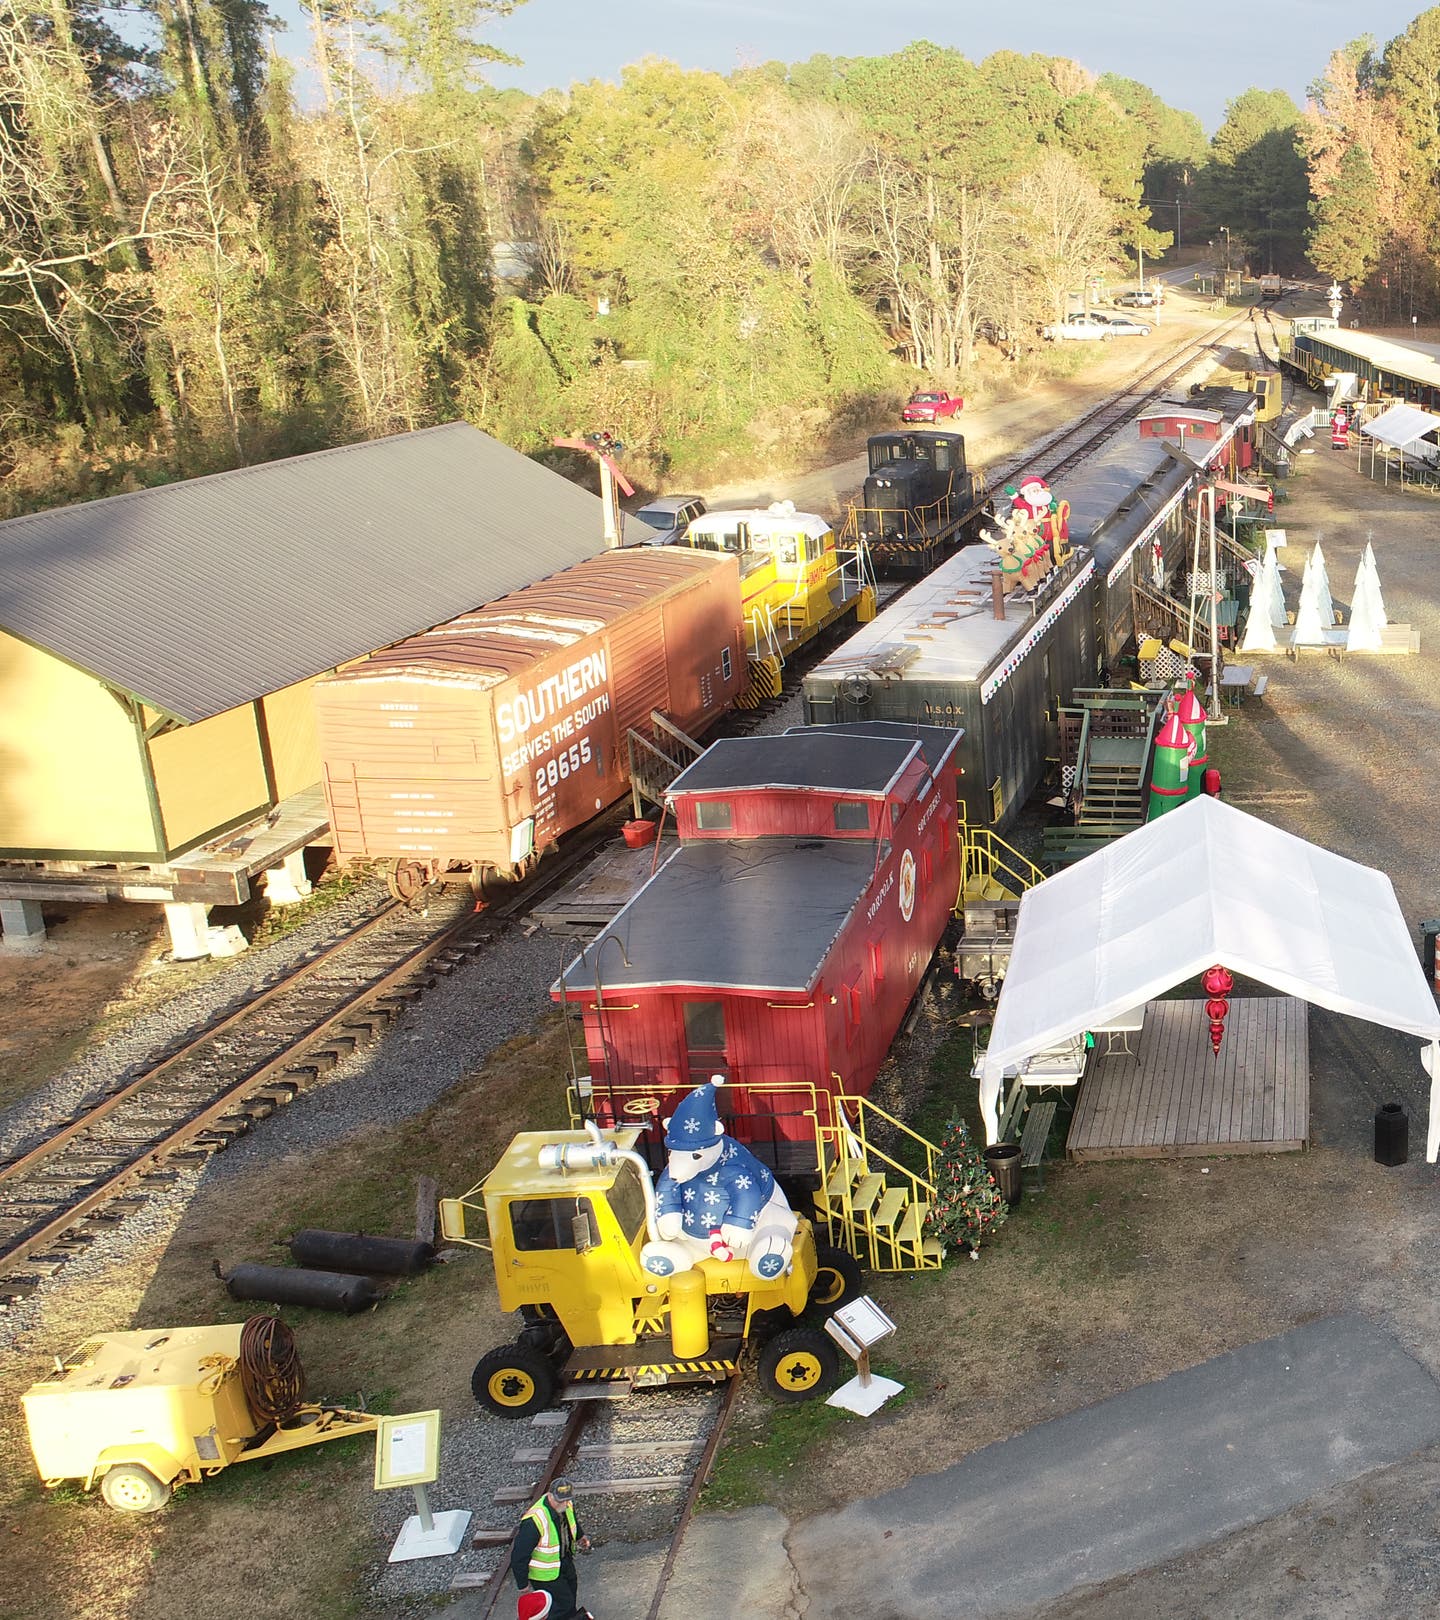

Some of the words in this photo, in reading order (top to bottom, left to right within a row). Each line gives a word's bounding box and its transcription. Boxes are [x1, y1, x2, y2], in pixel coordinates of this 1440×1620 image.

[496, 648, 607, 744] SOUTHERN
[502, 731, 552, 777] SERVES
[552, 715, 575, 744] THE
[574, 692, 610, 730] SOUTH
[535, 736, 592, 797] 28655
